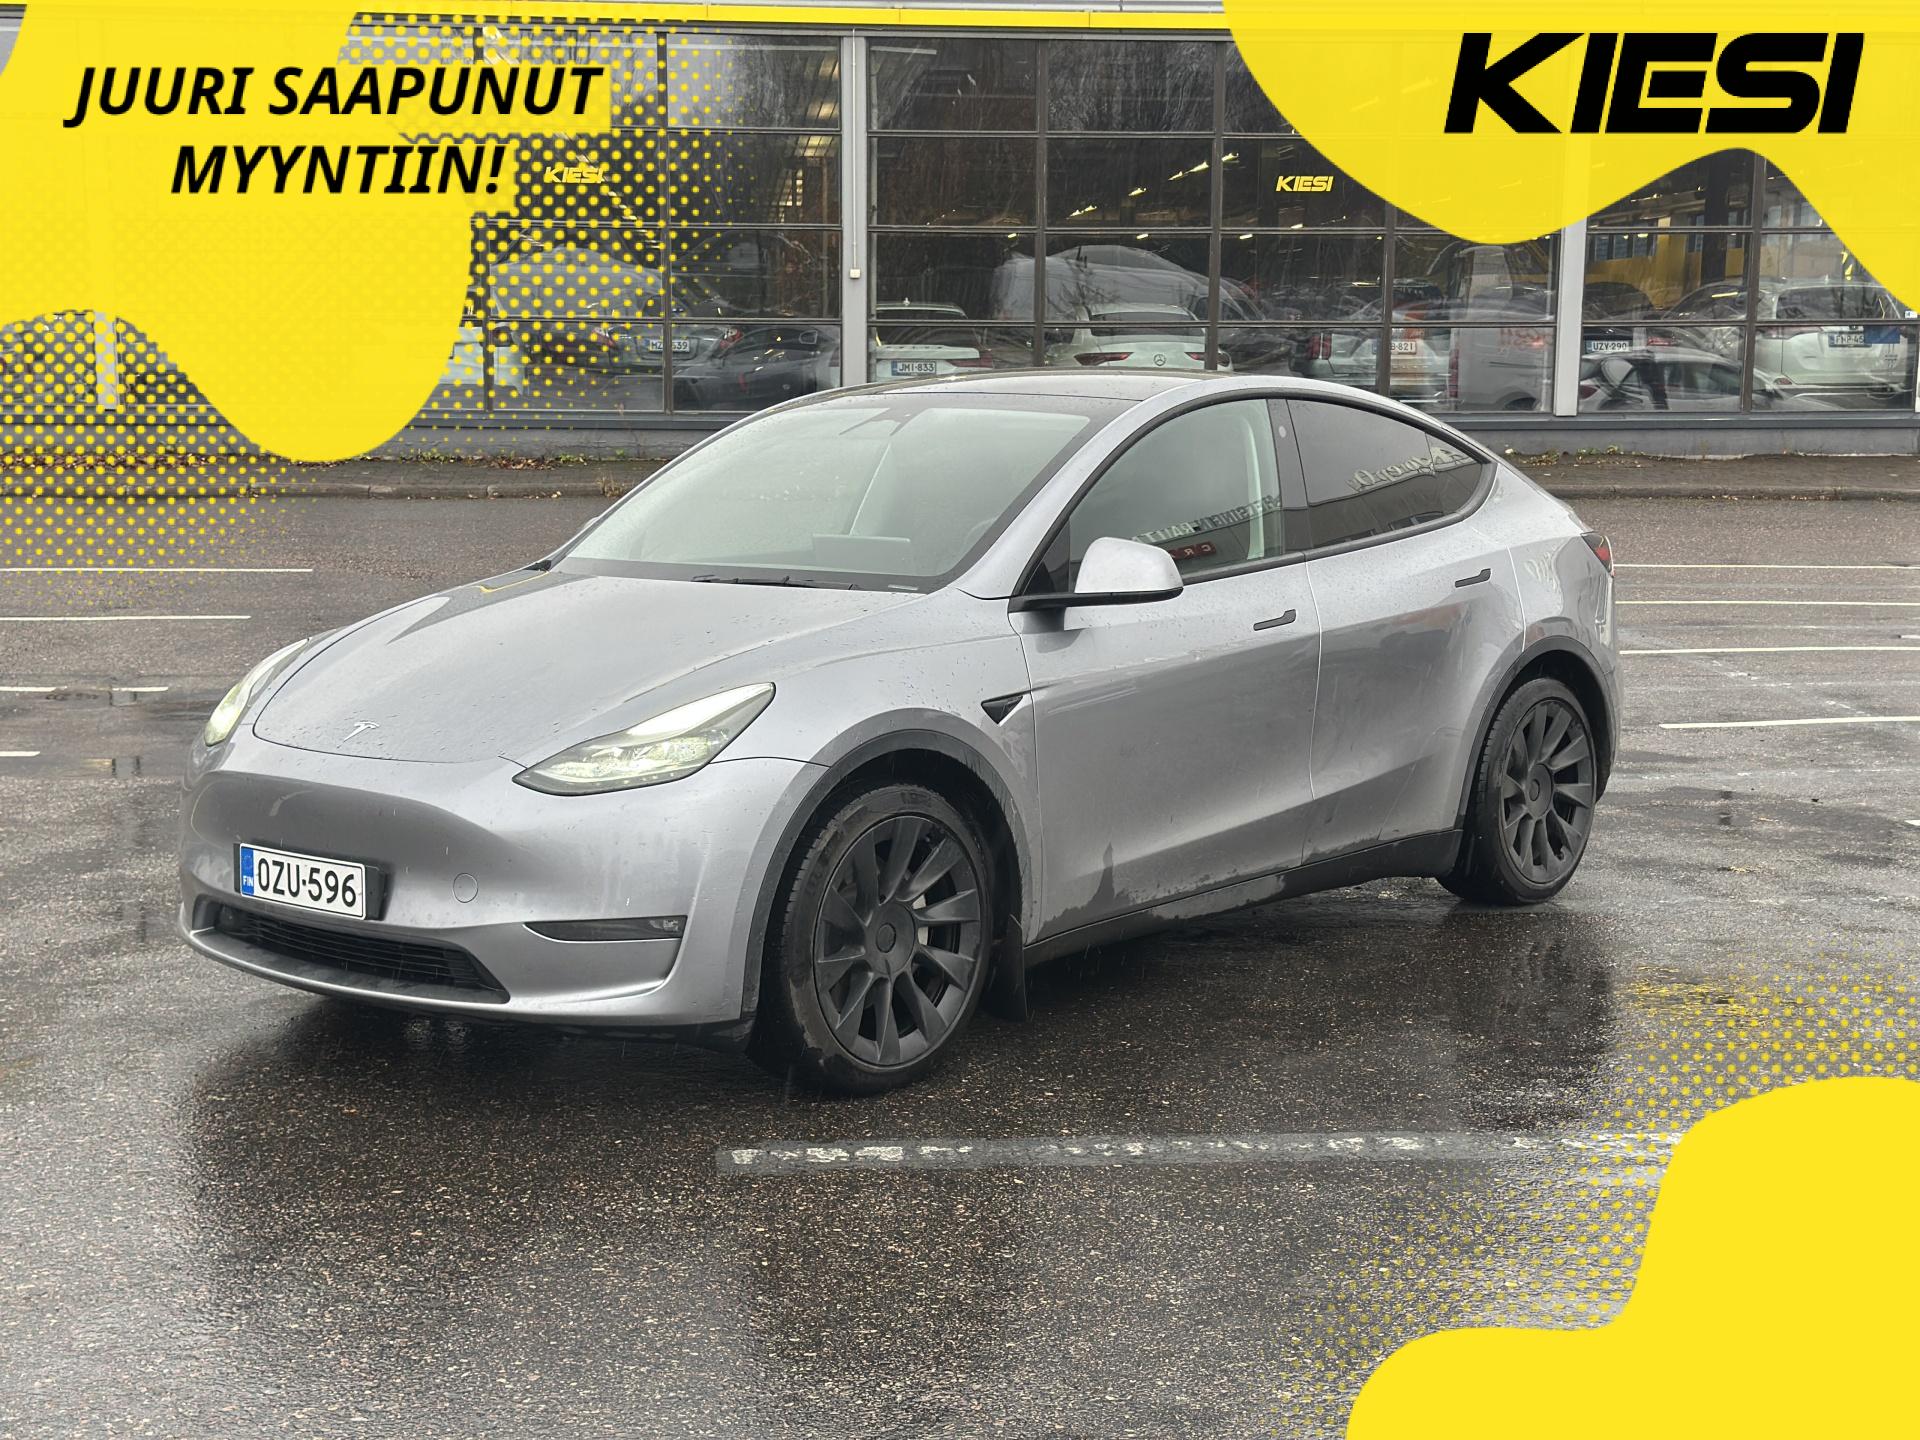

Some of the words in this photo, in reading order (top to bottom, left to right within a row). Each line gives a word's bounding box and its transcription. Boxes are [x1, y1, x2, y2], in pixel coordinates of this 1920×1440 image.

[544, 166, 605, 184] KIESI
[1275, 175, 1335, 192] KIESI
[1593, 342, 1627, 351] UZY-290
[898, 362, 935, 372] JMI-833
[242, 875, 254, 887] FIN
[257, 857, 357, 908] OZU-596
